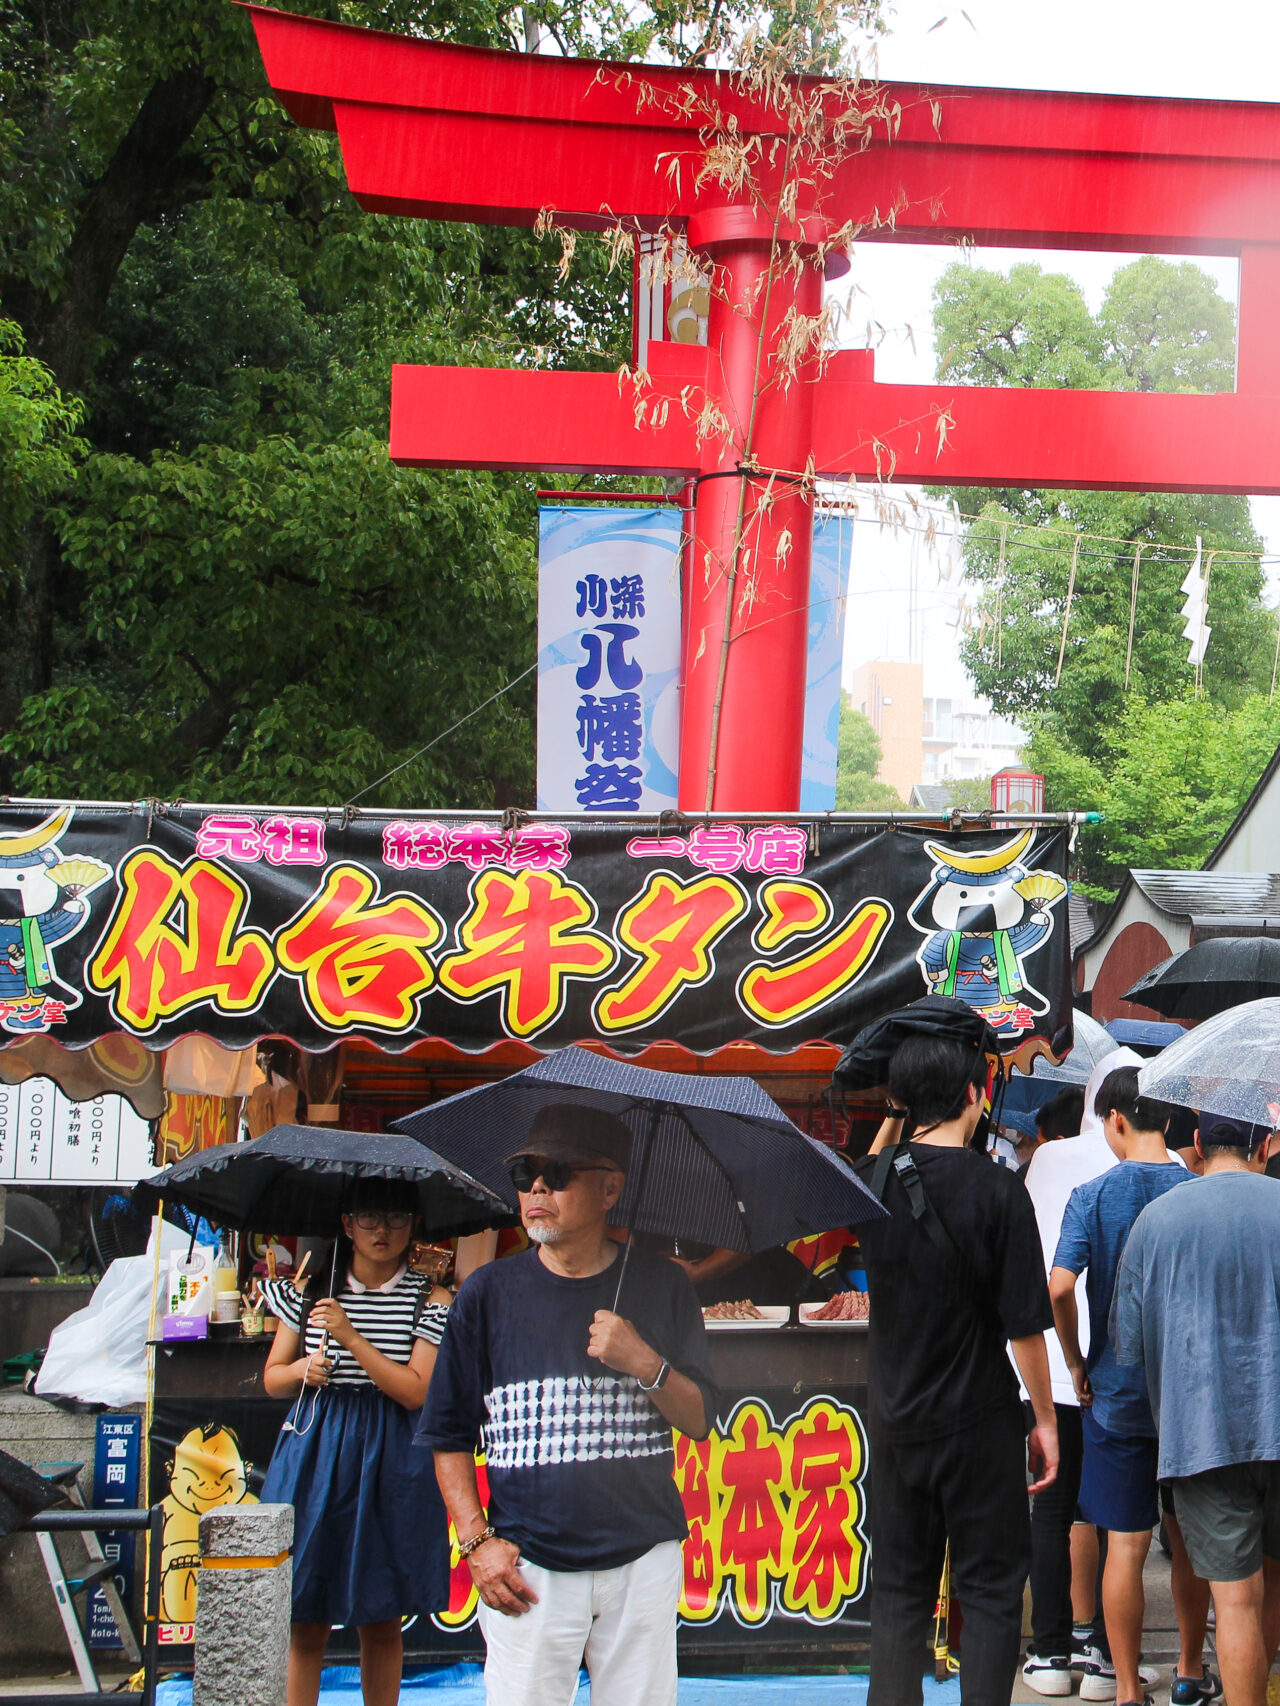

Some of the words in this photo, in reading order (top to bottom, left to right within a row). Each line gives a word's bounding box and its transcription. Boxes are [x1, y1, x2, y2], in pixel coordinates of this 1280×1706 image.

[196, 814, 328, 866] 元祖
[382, 820, 571, 871] 総本家
[627, 823, 808, 875] 一号店
[88, 845, 894, 1036] 仙台牛タン
[103, 1424, 134, 1435] 江東区
[104, 1438, 128, 1561] 富岡一目
